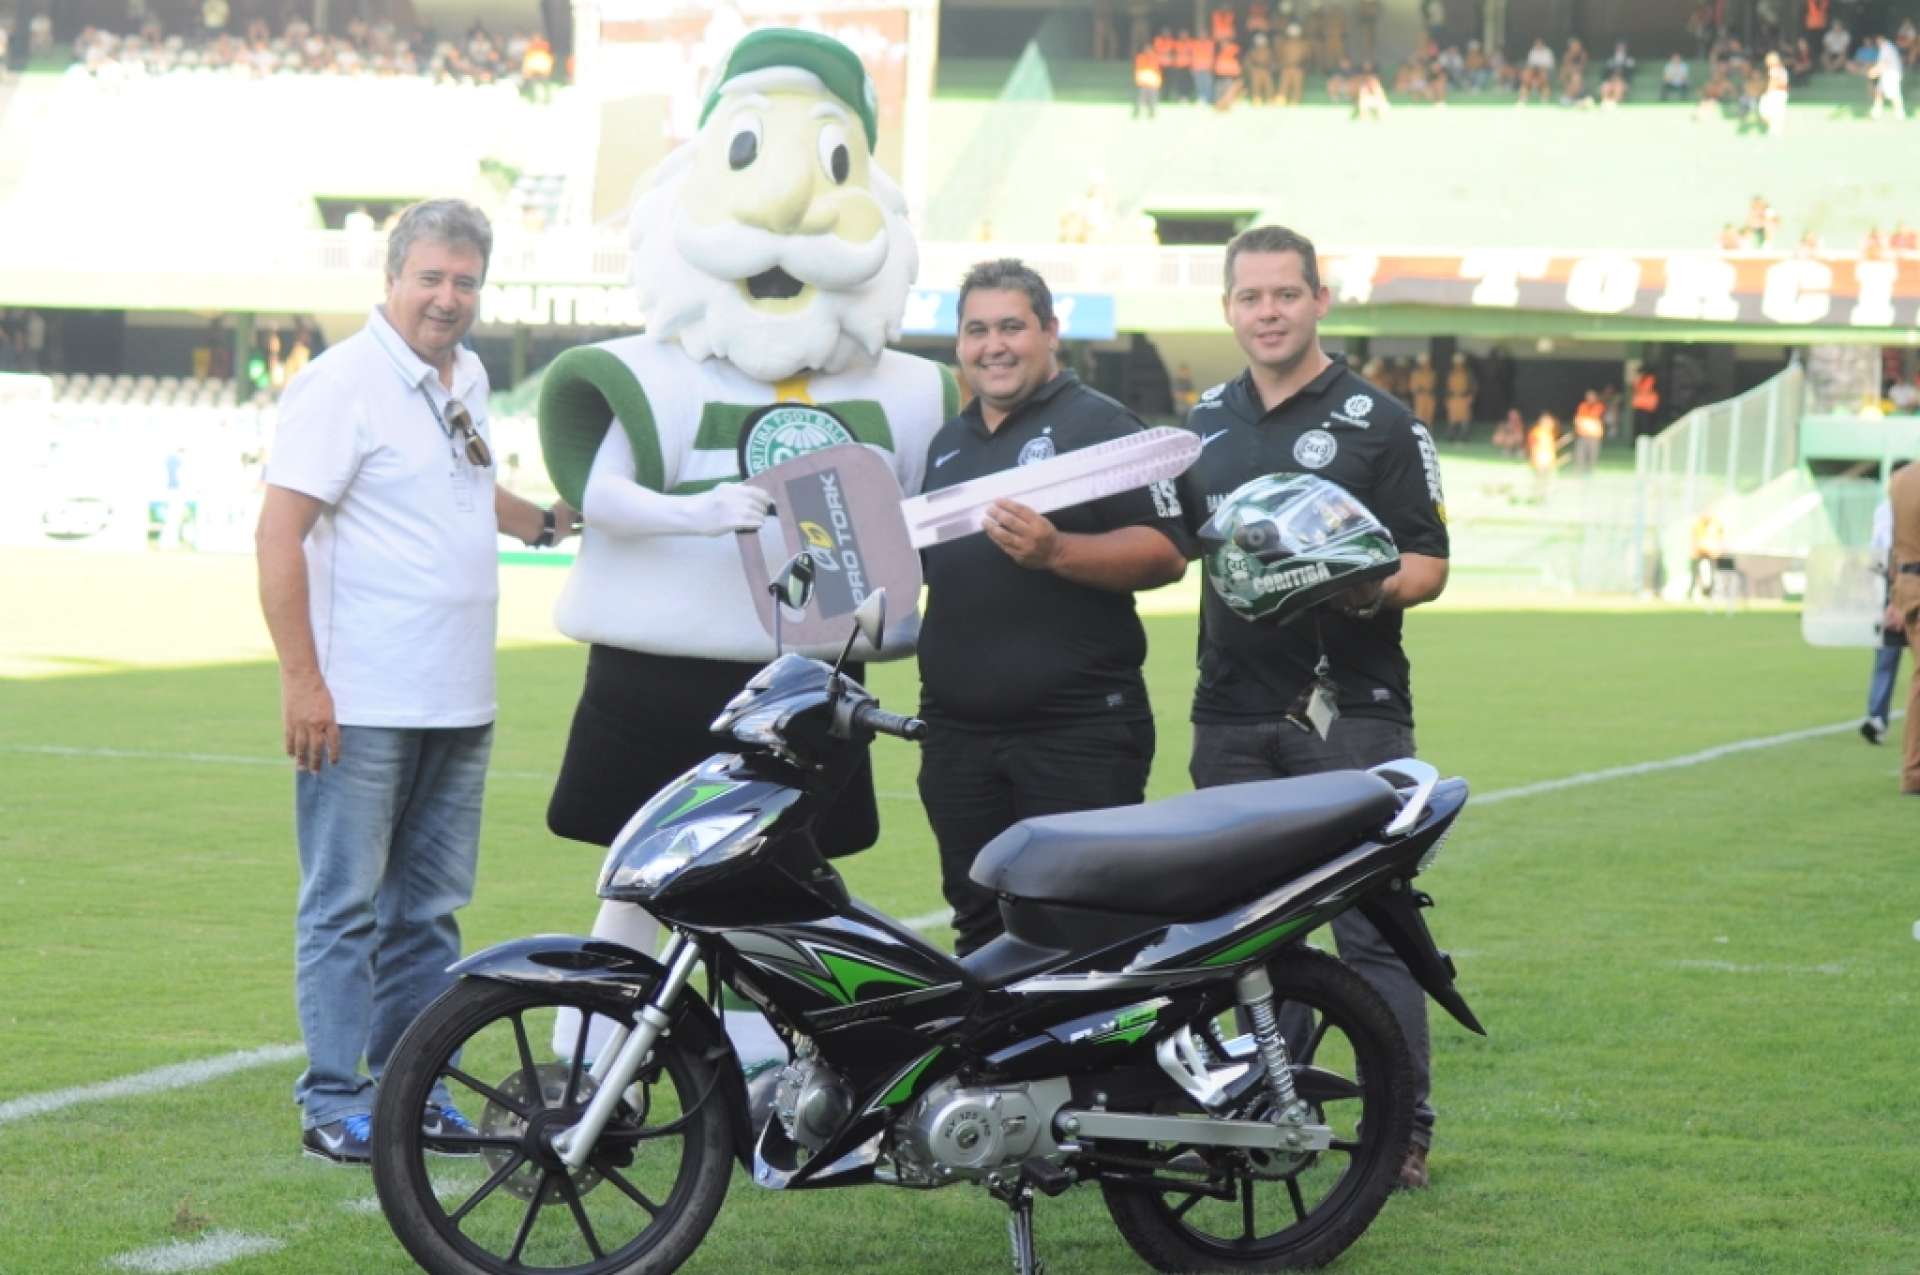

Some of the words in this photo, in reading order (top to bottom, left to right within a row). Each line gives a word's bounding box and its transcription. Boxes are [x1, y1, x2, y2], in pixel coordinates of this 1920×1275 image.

[1459, 256, 1920, 326] TORCI
[819, 472, 852, 546] TORK
[841, 550, 865, 606] PRO
